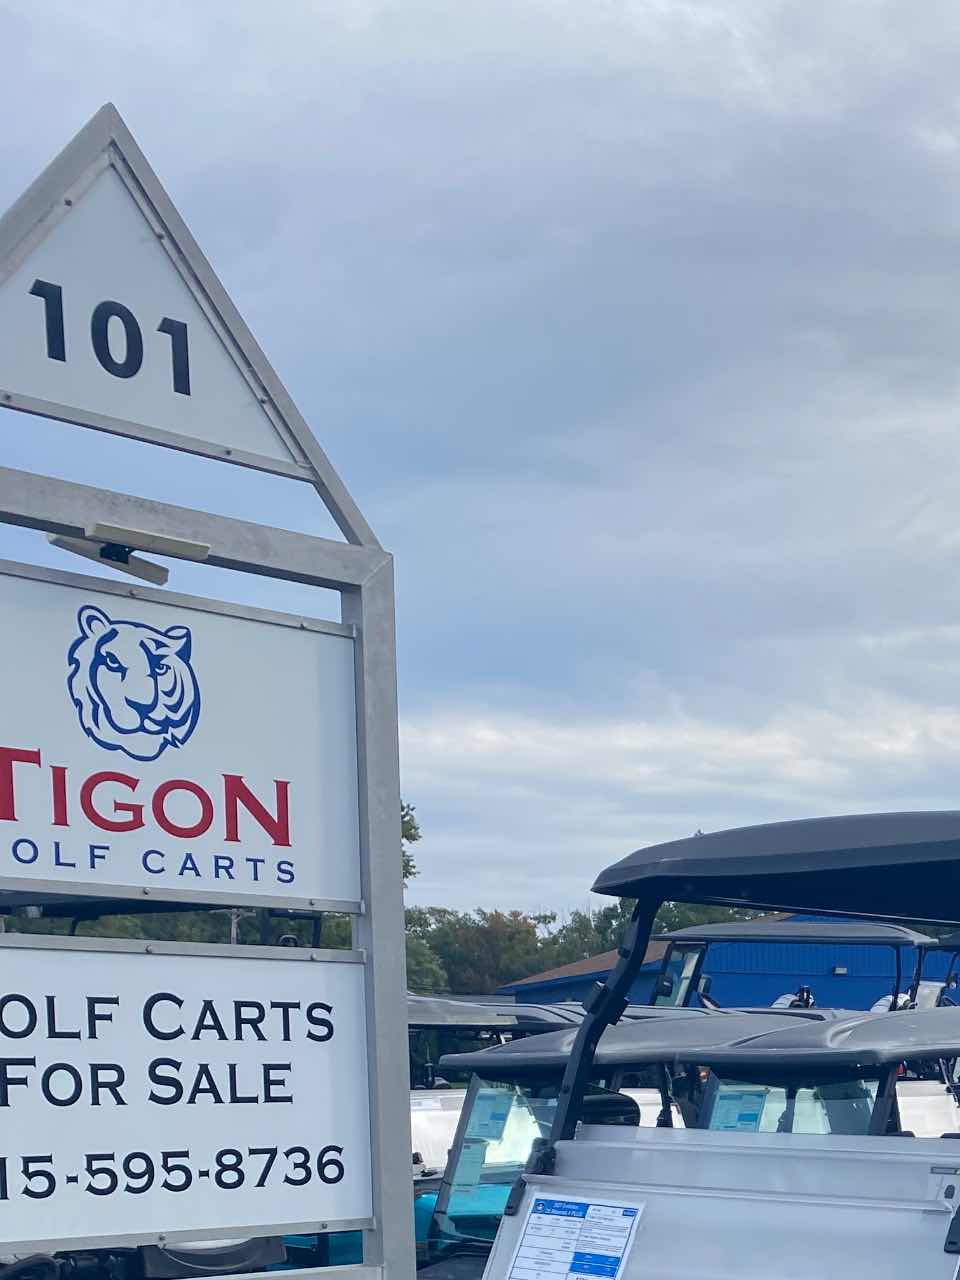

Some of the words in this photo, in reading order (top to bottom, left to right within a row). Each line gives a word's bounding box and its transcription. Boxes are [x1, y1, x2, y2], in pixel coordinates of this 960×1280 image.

[28, 278, 191, 397] 101
[0, 747, 292, 848] TIGON
[142, 849, 295, 884] CARTS
[143, 992, 335, 1043] CARTS
[0, 1055, 128, 1107] FOR
[148, 1057, 294, 1106] SALE
